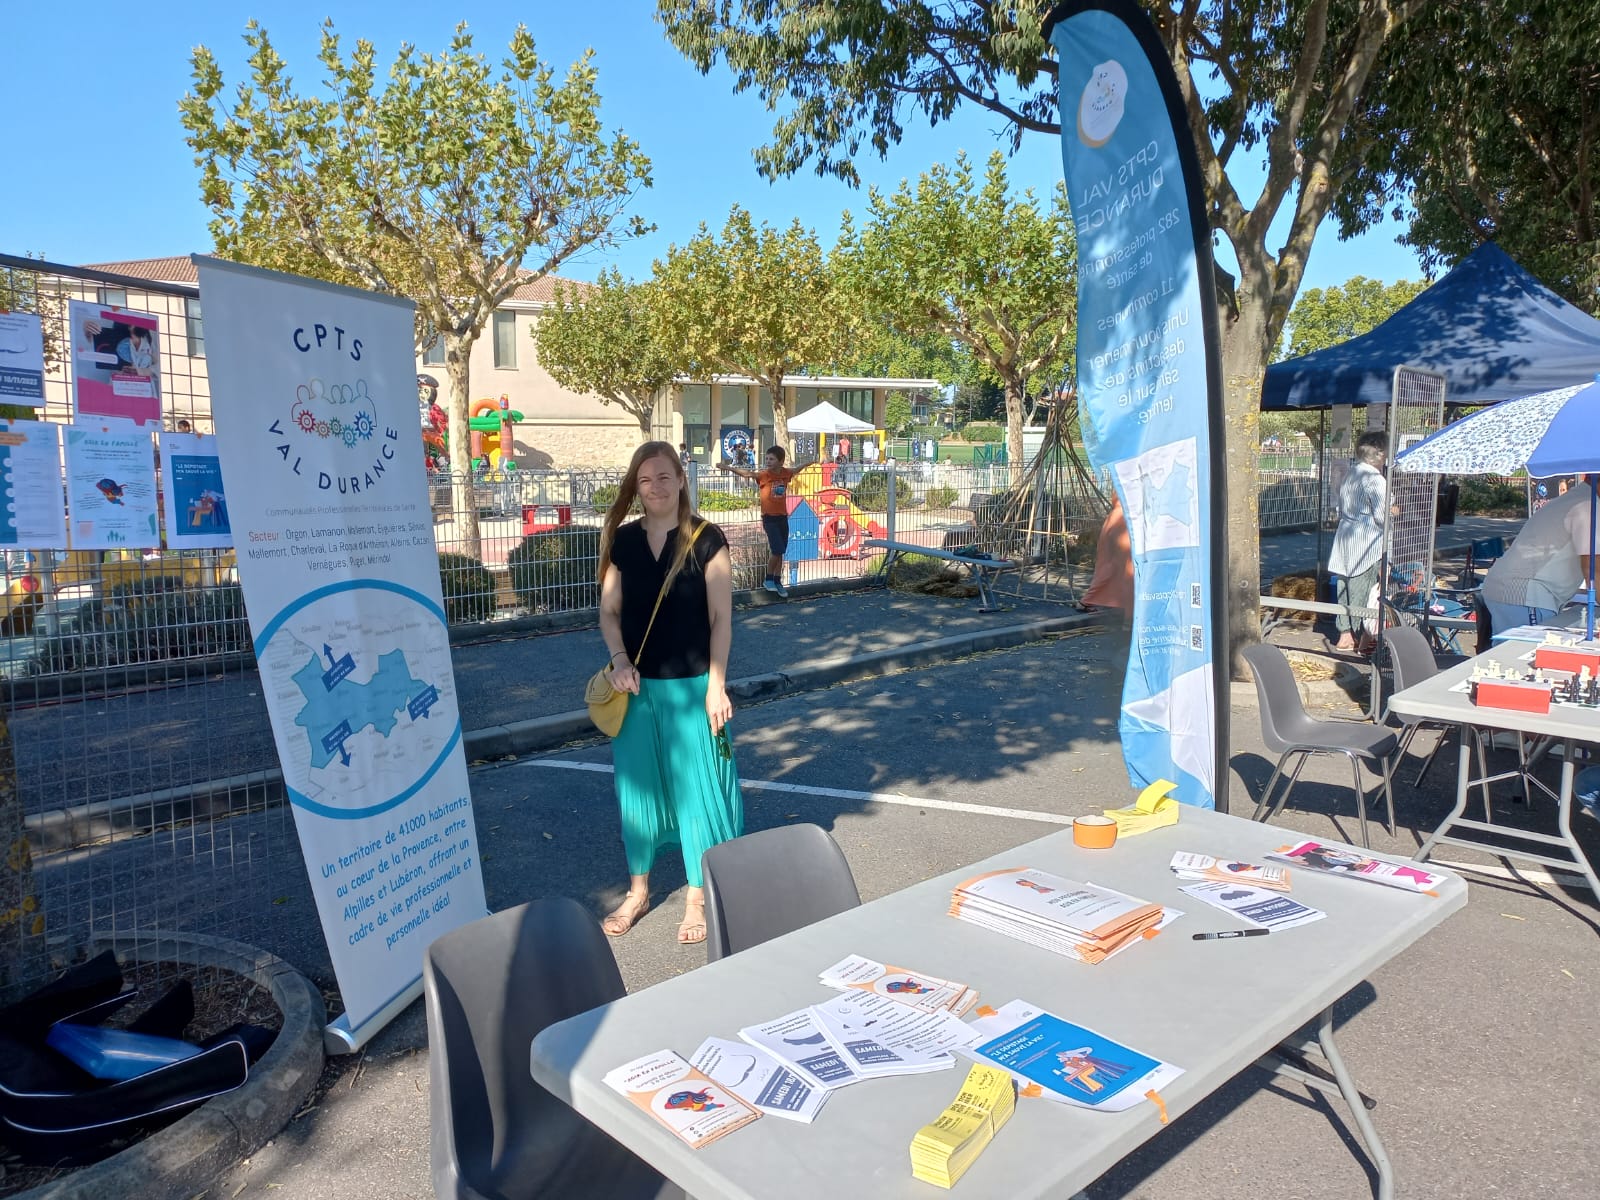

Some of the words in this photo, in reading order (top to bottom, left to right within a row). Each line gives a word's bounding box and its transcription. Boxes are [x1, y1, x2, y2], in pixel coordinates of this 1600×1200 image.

[293, 324, 363, 361] CPTS
[268, 419, 301, 475] VAL
[318, 426, 398, 494] DURANCE
[329, 543, 338, 553] La
[321, 864, 336, 879] Un
[338, 840, 382, 869] territoire
[385, 831, 396, 844] de
[399, 814, 426, 837] 41000
[336, 884, 348, 898] au
[351, 869, 375, 890] coeur
[378, 860, 390, 873] de
[392, 853, 400, 866] la
[402, 832, 442, 859] Provence,
[444, 818, 467, 837] entre
[344, 892, 375, 921] Alpilles
[378, 885, 388, 899] et
[389, 864, 427, 893] Lubéron,
[428, 845, 457, 869] offrant
[459, 838, 470, 851] un
[348, 921, 375, 945] cadre
[377, 912, 389, 926] de
[390, 902, 403, 917] vie
[405, 863, 461, 911] professionnelle
[463, 856, 472, 870] et
[386, 908, 431, 951] personnelle
[432, 892, 451, 914] idéal
